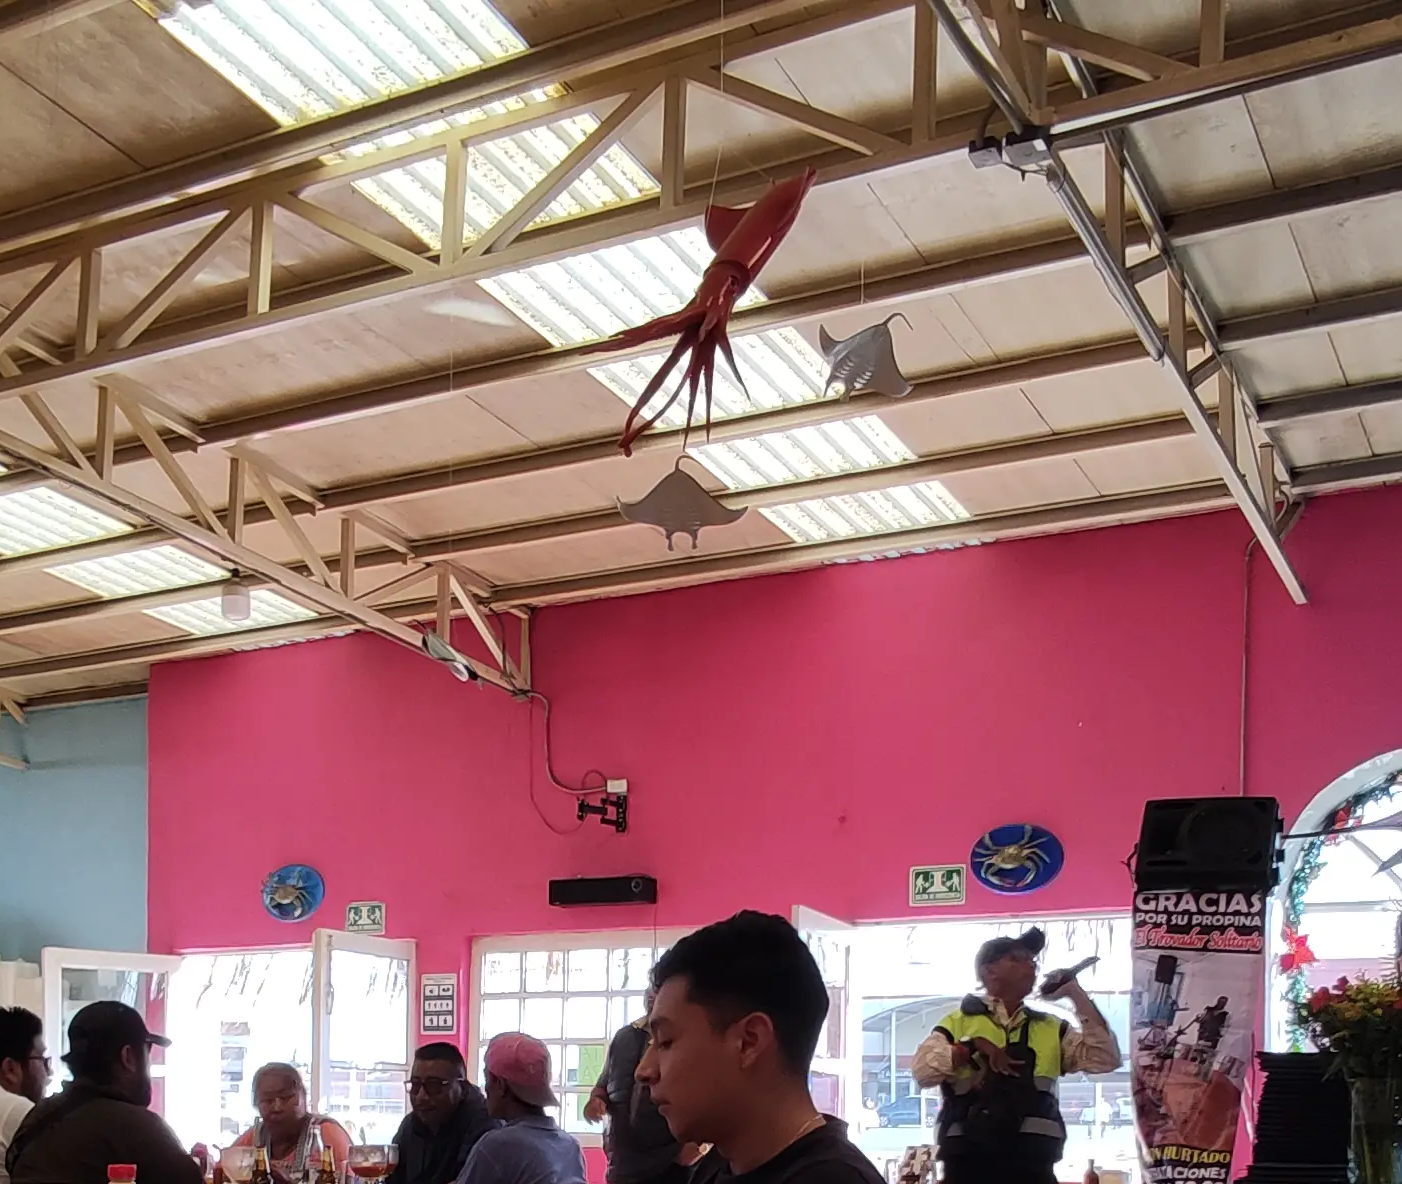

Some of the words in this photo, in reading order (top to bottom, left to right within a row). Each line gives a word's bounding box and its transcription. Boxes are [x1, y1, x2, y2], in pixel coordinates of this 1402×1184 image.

[1136, 893, 1262, 913] GRACIAS
[1135, 912, 1168, 925] POR
[1170, 914, 1190, 926] SU
[1191, 915, 1262, 927] PROPINA
[1163, 1146, 1230, 1164] HURTADO
